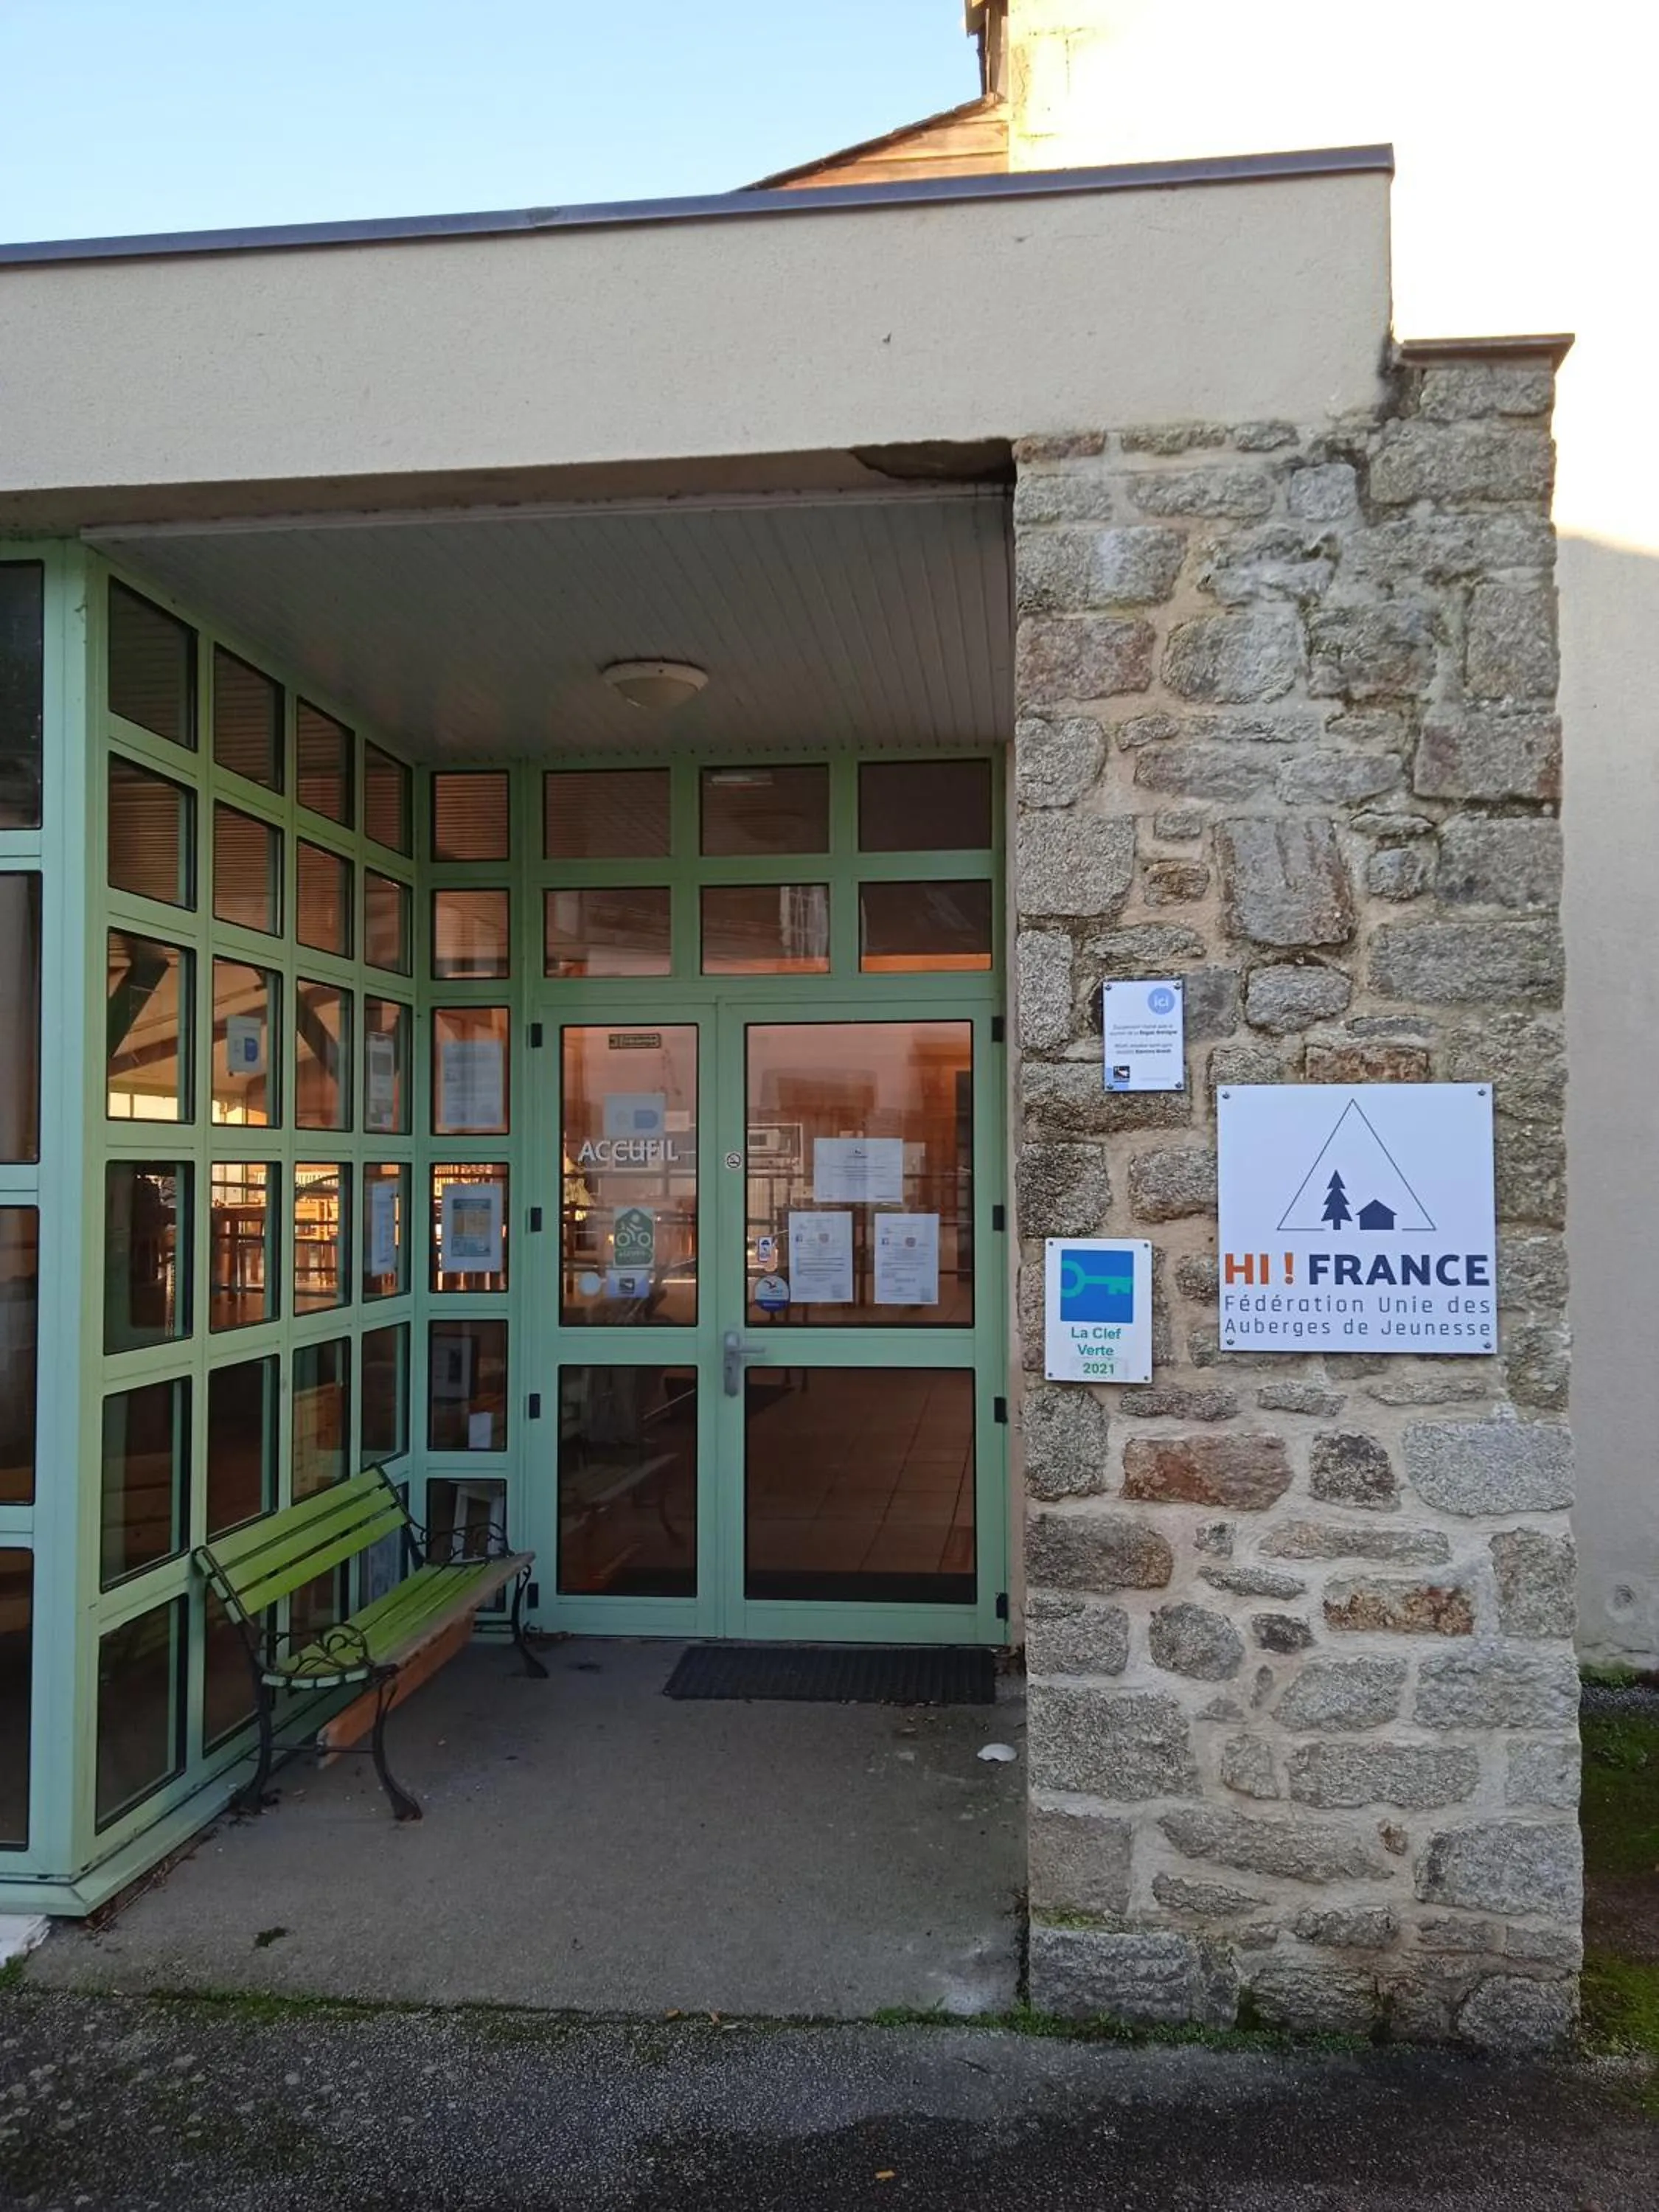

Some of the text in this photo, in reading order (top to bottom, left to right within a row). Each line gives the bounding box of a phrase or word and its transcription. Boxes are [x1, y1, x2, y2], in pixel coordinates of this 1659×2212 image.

[577, 1140, 680, 1161] ACCUEIL
[1225, 1253, 1269, 1284] HI
[1309, 1254, 1490, 1286] FRANCE
[1225, 1294, 1490, 1313] Fédération Unie des
[1071, 1326, 1121, 1339] La Clef
[1225, 1318, 1490, 1337] Auberges de Jeunesse
[1077, 1343, 1114, 1355] Verte
[1082, 1362, 1114, 1374] 2021
